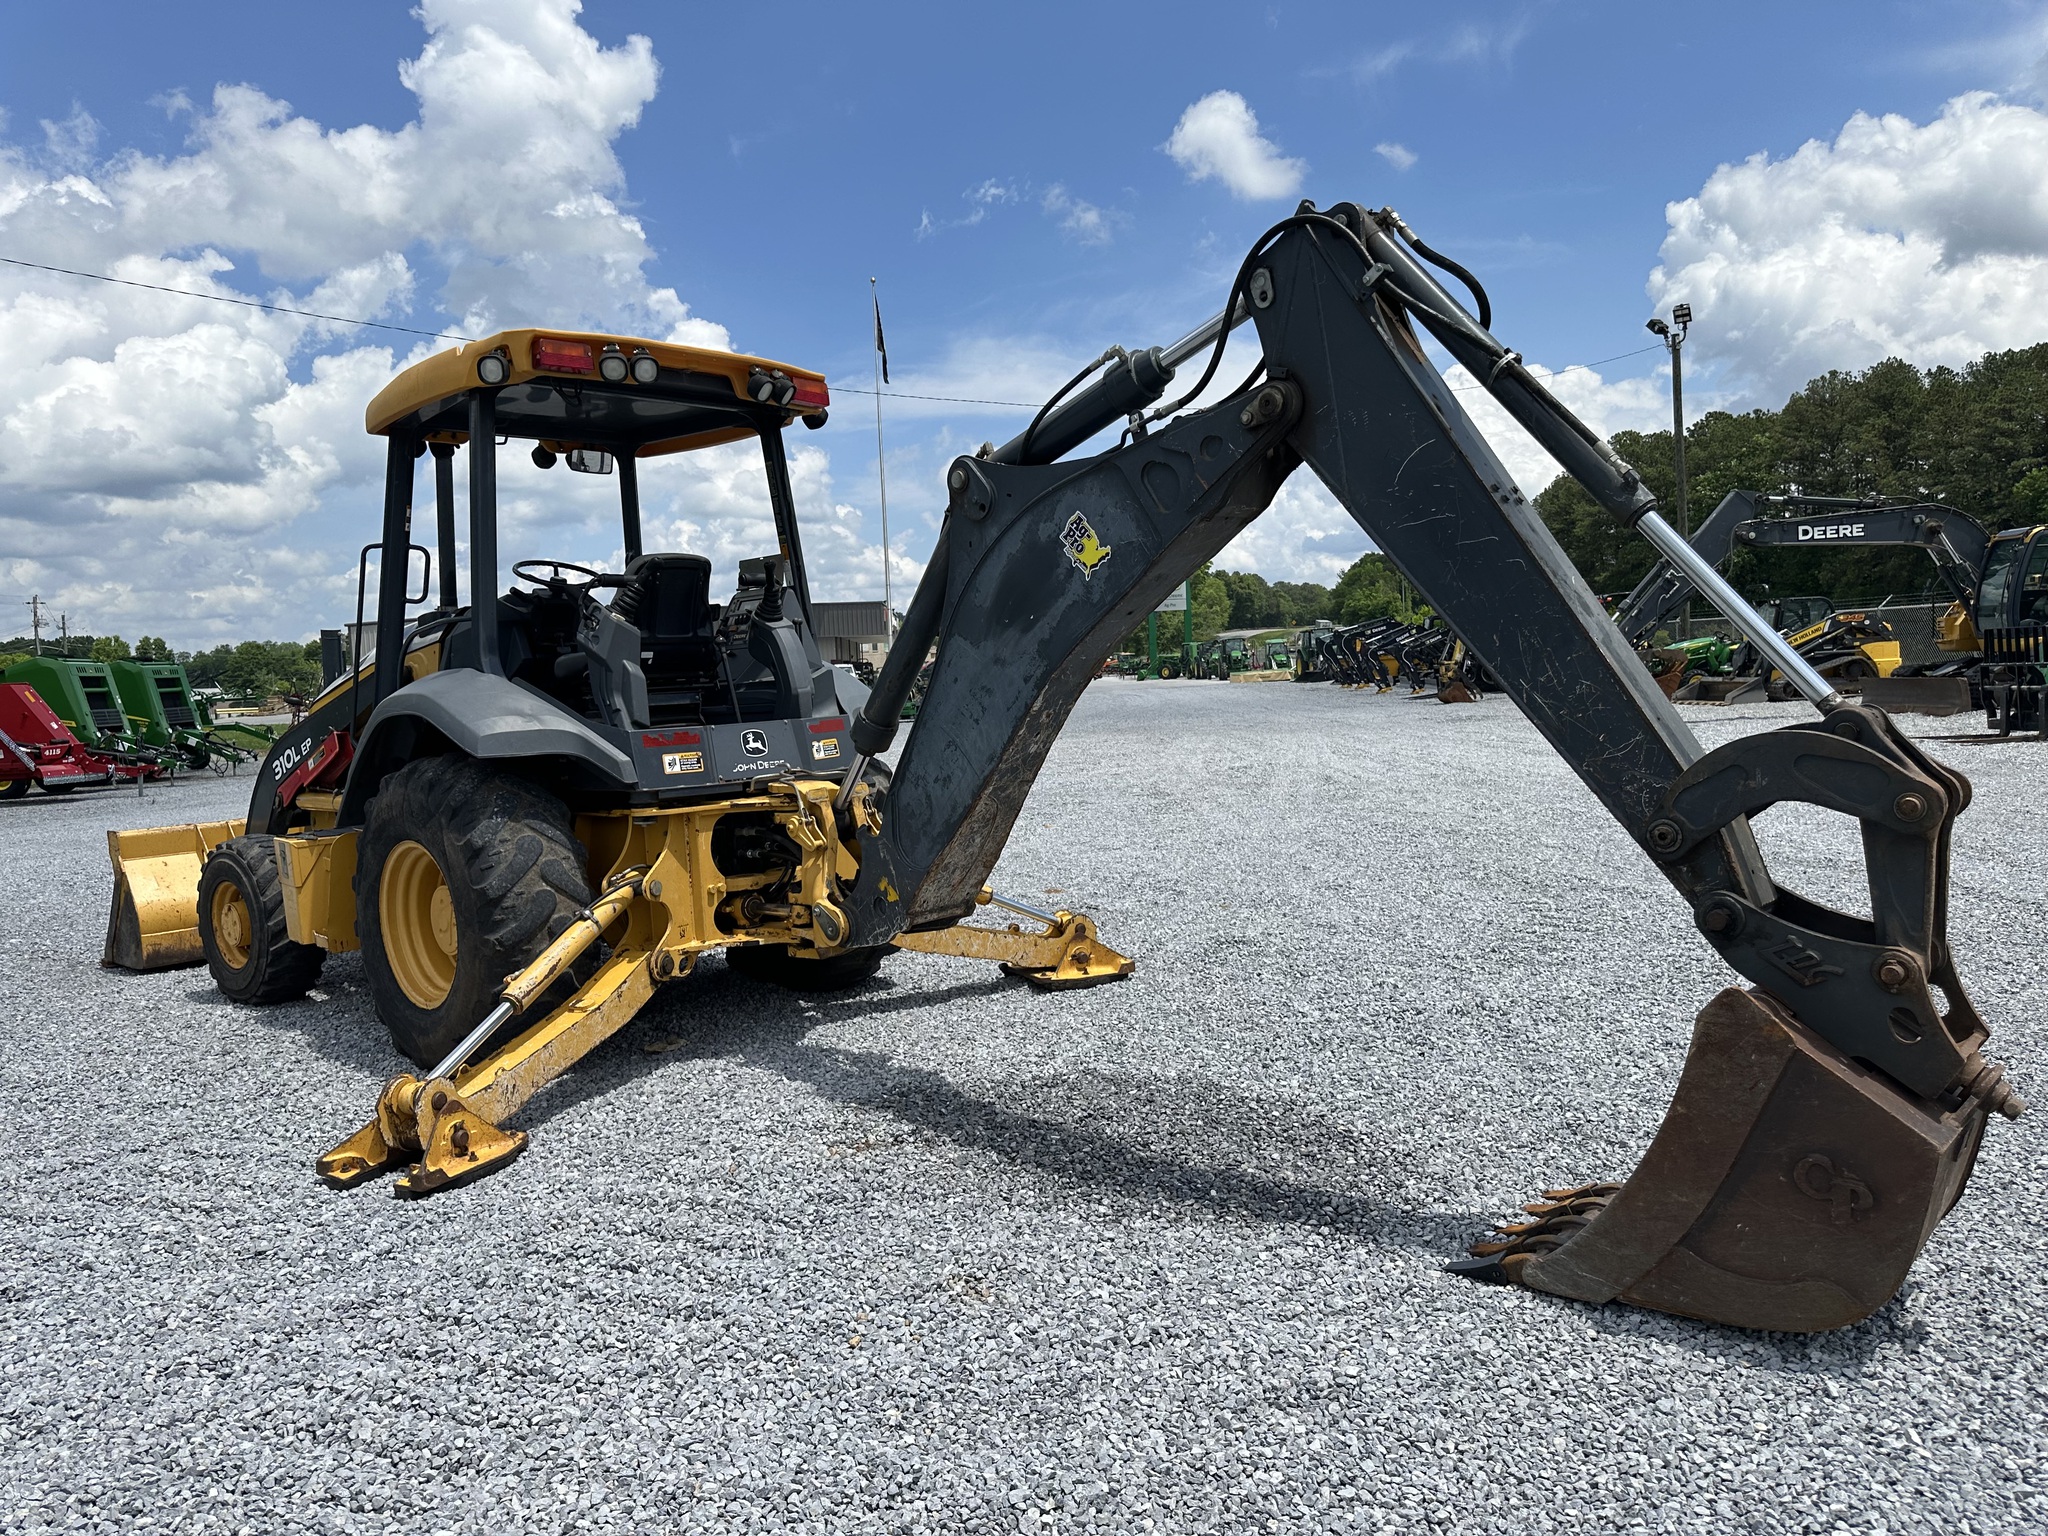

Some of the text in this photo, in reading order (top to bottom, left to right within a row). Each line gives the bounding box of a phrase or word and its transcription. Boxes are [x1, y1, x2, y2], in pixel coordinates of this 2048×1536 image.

[1070, 516, 1091, 539] Ag-
[1798, 523, 1865, 541] DEERE
[1063, 527, 1084, 553] Pro
[1396, 633, 1409, 642] DEERE
[1799, 626, 1822, 641] HOLLAND
[44, 748, 61, 756] 4115
[272, 746, 301, 781] 310L
[301, 737, 312, 755] EP
[733, 763, 757, 773] JOHN
